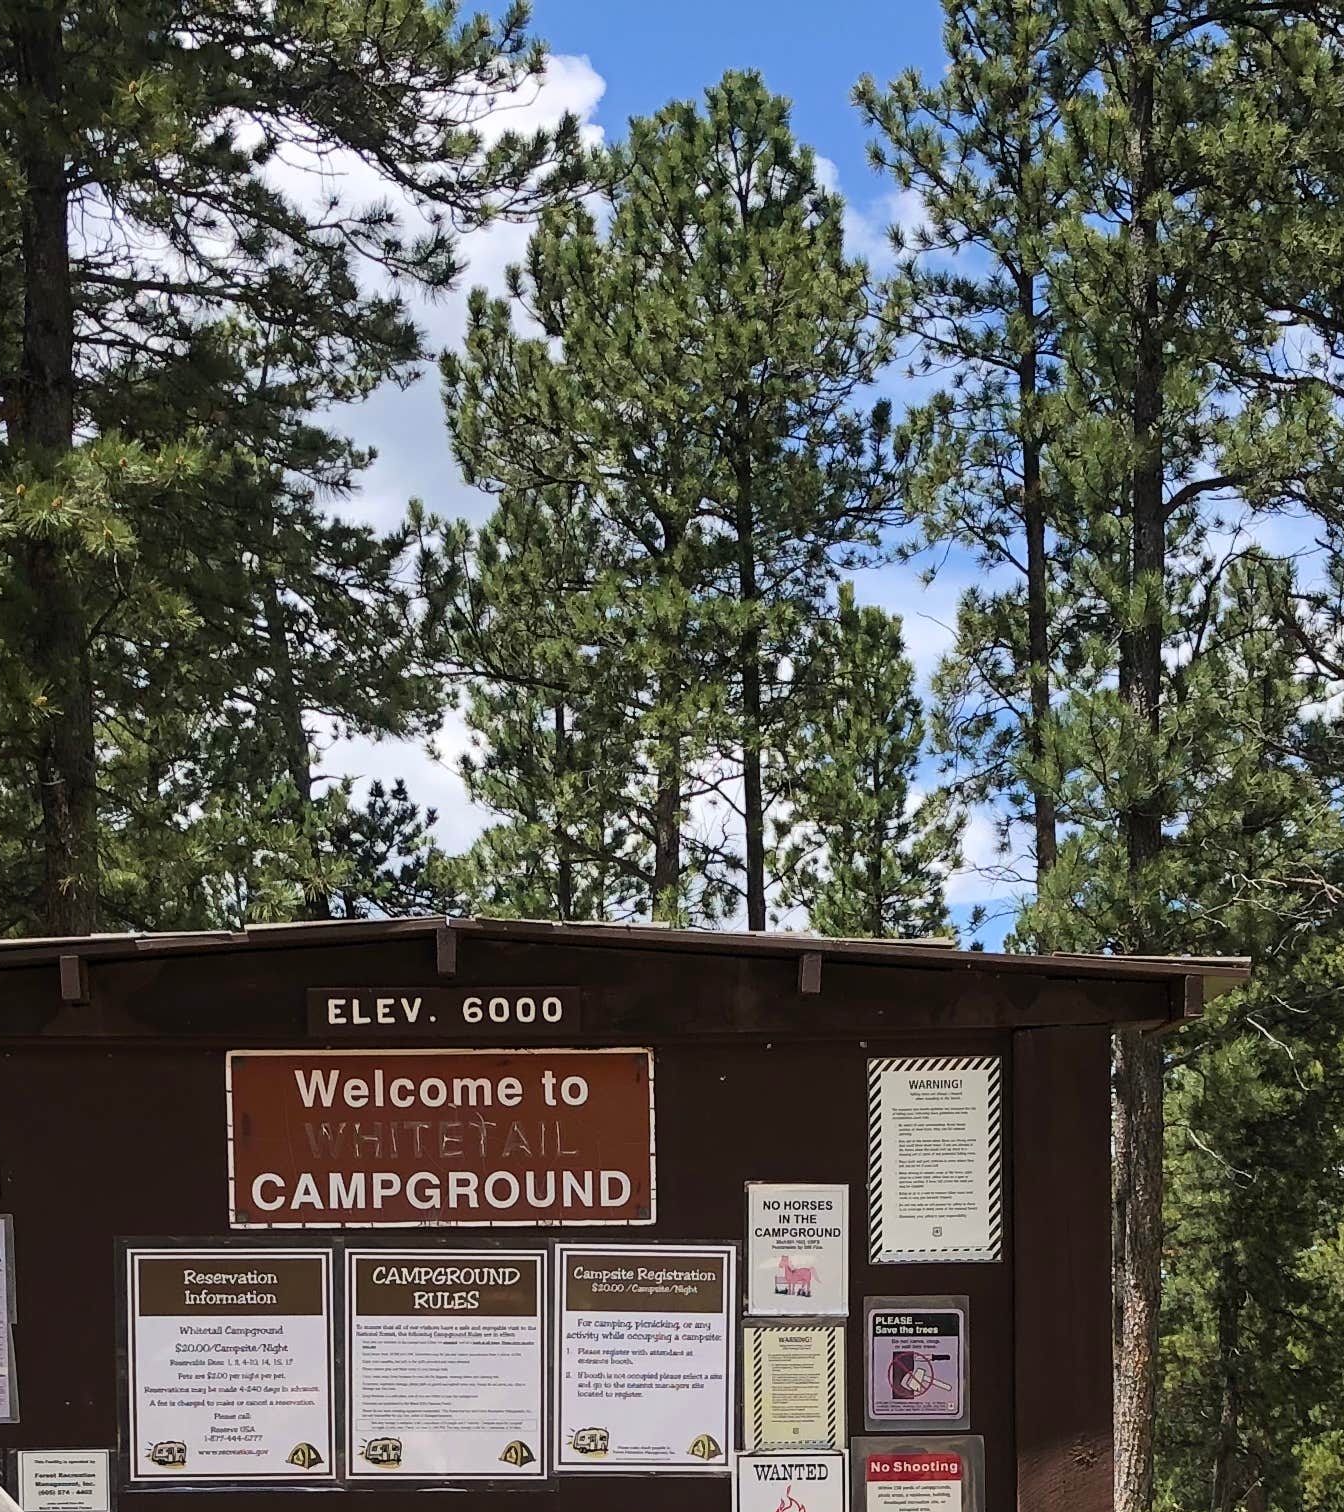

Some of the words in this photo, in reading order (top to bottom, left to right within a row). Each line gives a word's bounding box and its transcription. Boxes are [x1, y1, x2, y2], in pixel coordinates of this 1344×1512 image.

[327, 997, 438, 1025] ELEV.
[462, 997, 563, 1025] 6000
[294, 1069, 524, 1108] Welcome
[542, 1069, 590, 1108] to
[908, 1079, 963, 1089] WARNING!
[303, 1117, 578, 1159] WHITETAIL
[251, 1171, 633, 1211] CAMPGROUND
[762, 1200, 781, 1211] NO
[784, 1200, 833, 1211] HORSES
[778, 1214, 790, 1224] IN
[794, 1214, 817, 1224] THE
[754, 1227, 841, 1238] CAMPGROUND
[183, 1270, 278, 1284] Reservation
[372, 1266, 521, 1285] CAMPGROUND
[573, 1267, 634, 1283] Campsite
[638, 1268, 716, 1284] Registration
[184, 1290, 278, 1305] Information
[413, 1291, 480, 1309] RULES
[577, 1319, 592, 1328] For
[635, 1319, 680, 1331] picnicking,
[682, 1321, 692, 1329] or
[694, 1321, 712, 1331] any
[875, 1317, 913, 1325] PLEASE
[180, 1326, 223, 1335] Whitetail
[224, 1326, 284, 1337] Campground
[566, 1331, 599, 1341] activity
[602, 1331, 624, 1340] while
[627, 1333, 672, 1342] occupying
[876, 1326, 898, 1334] Save
[899, 1326, 914, 1334] the
[916, 1326, 938, 1334] trees
[753, 1464, 829, 1481] WANTED
[870, 1461, 890, 1473] No
[894, 1461, 958, 1473] Shooting
